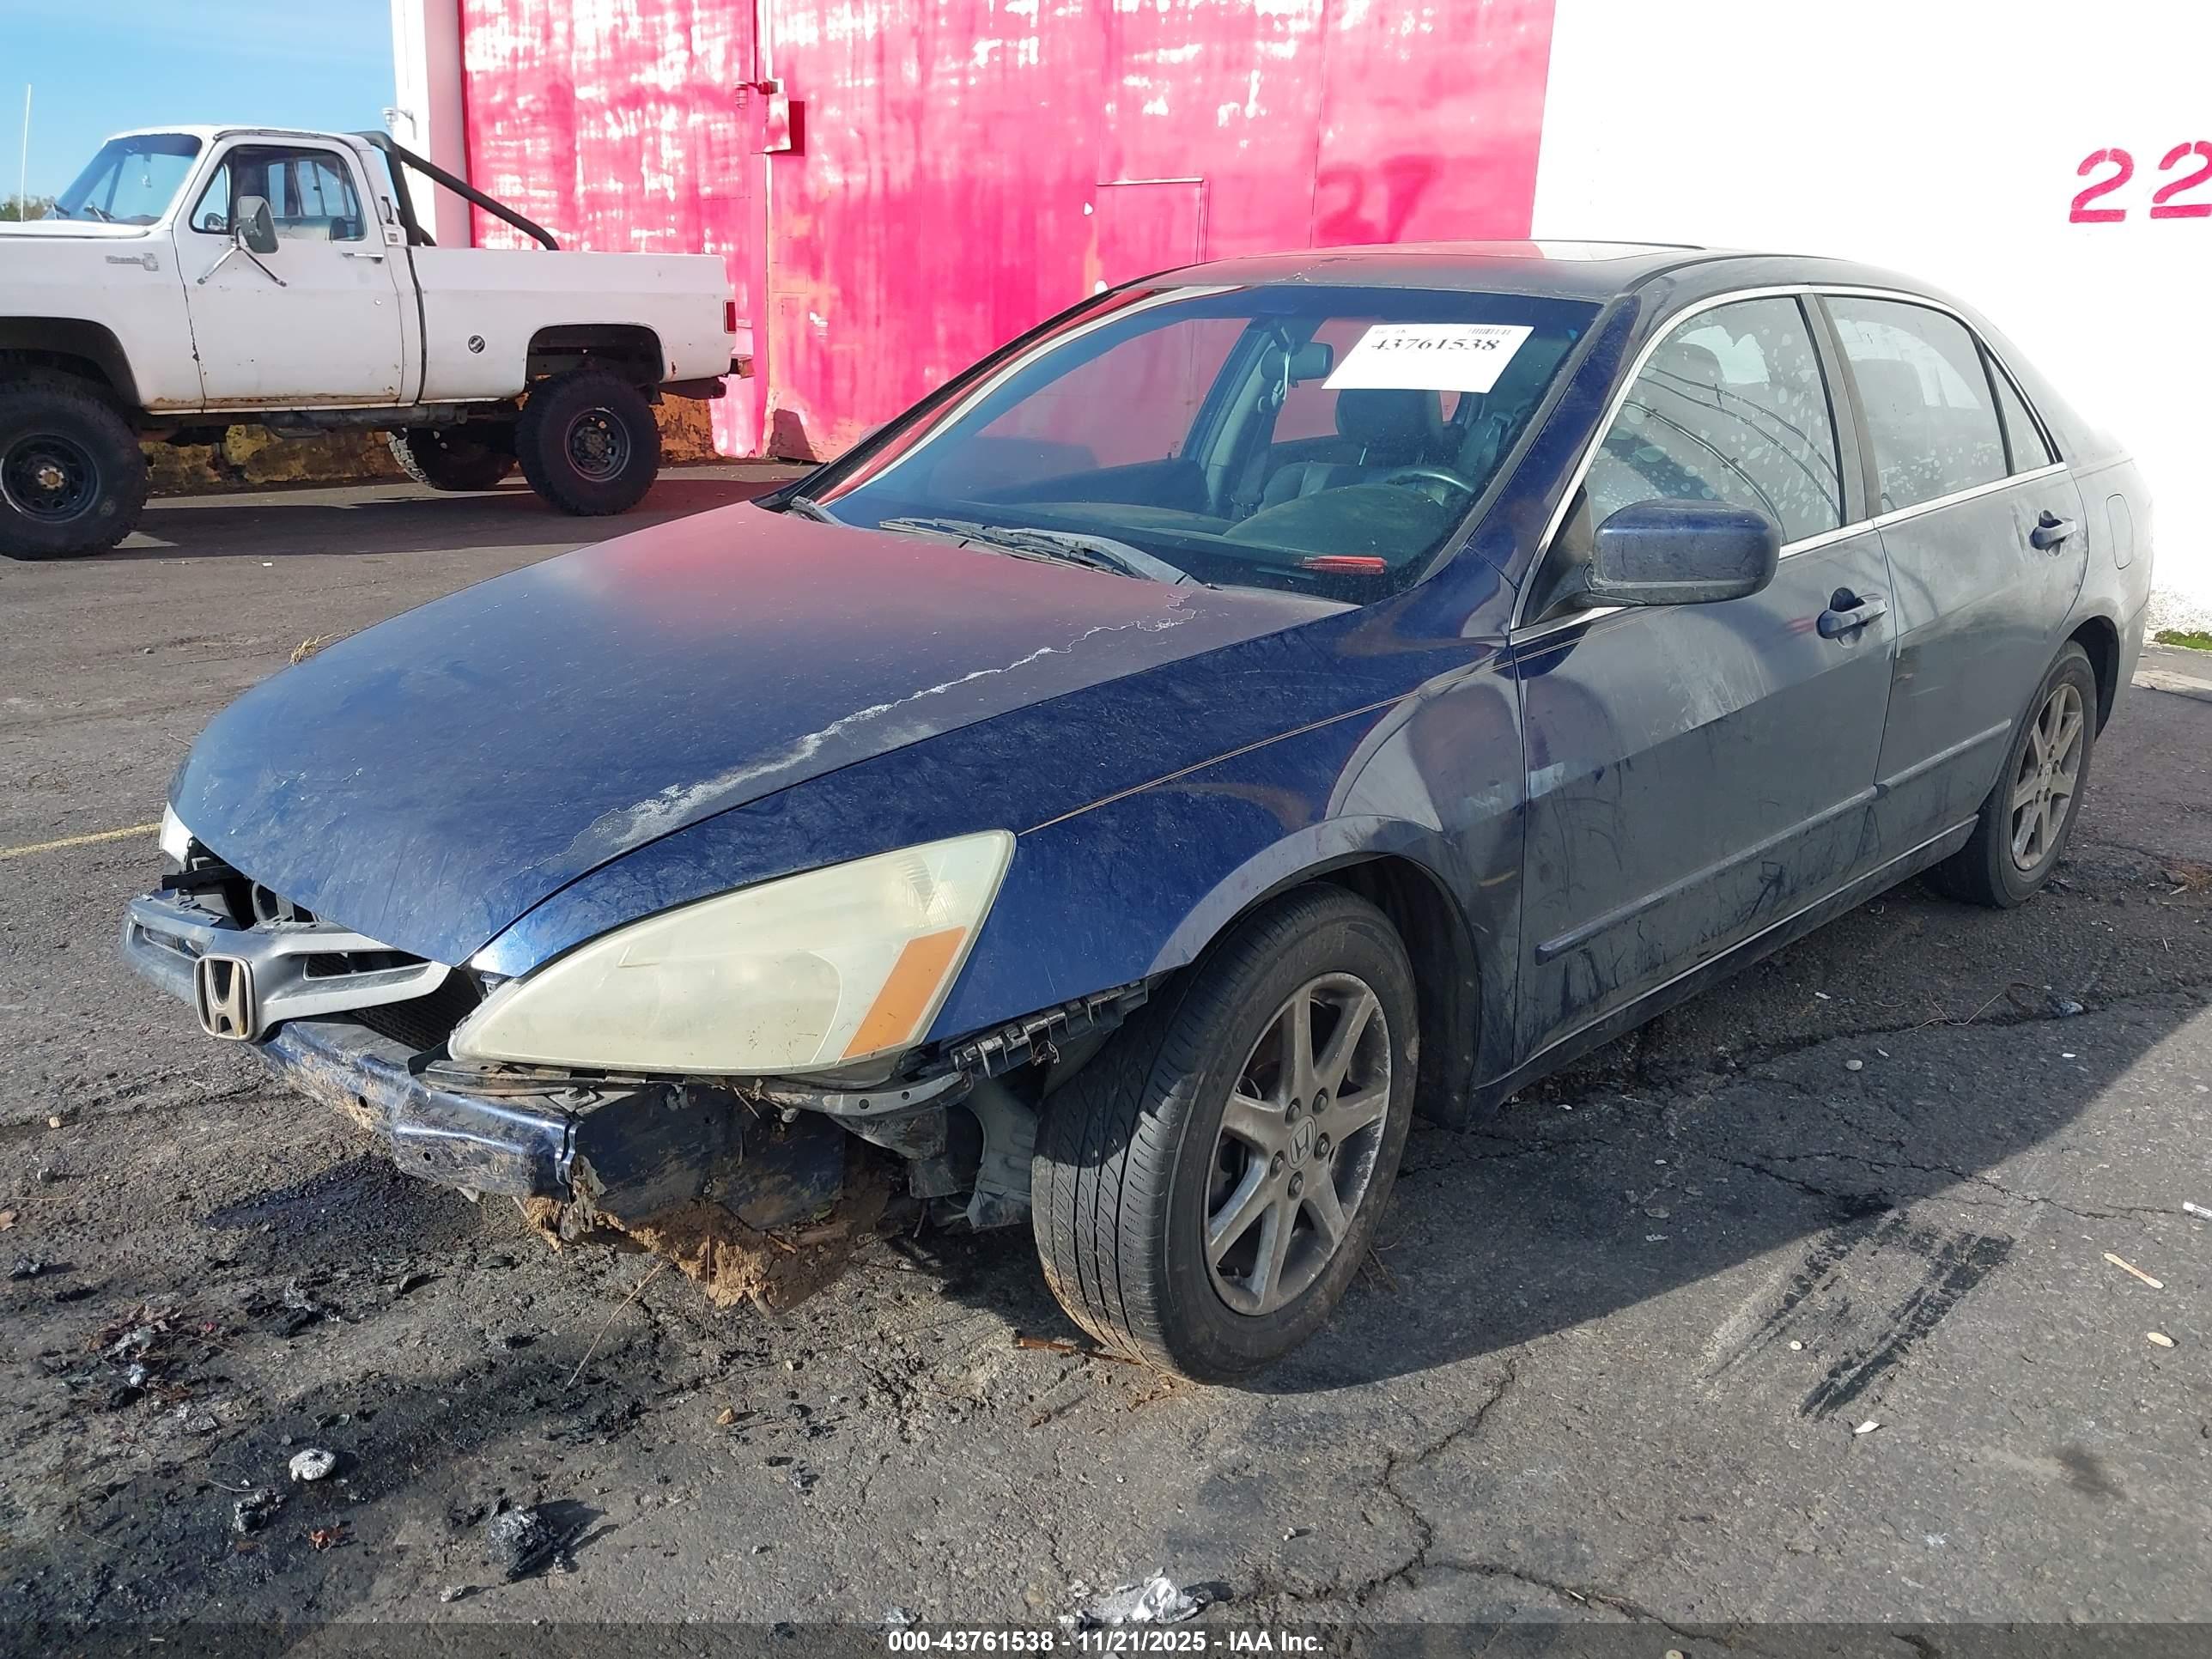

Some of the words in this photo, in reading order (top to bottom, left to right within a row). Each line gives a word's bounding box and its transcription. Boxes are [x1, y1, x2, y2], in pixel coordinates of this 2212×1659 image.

[1316, 155, 1444, 245] 27
[2069, 141, 2212, 223] 22
[1371, 338, 1500, 350] 43761538
